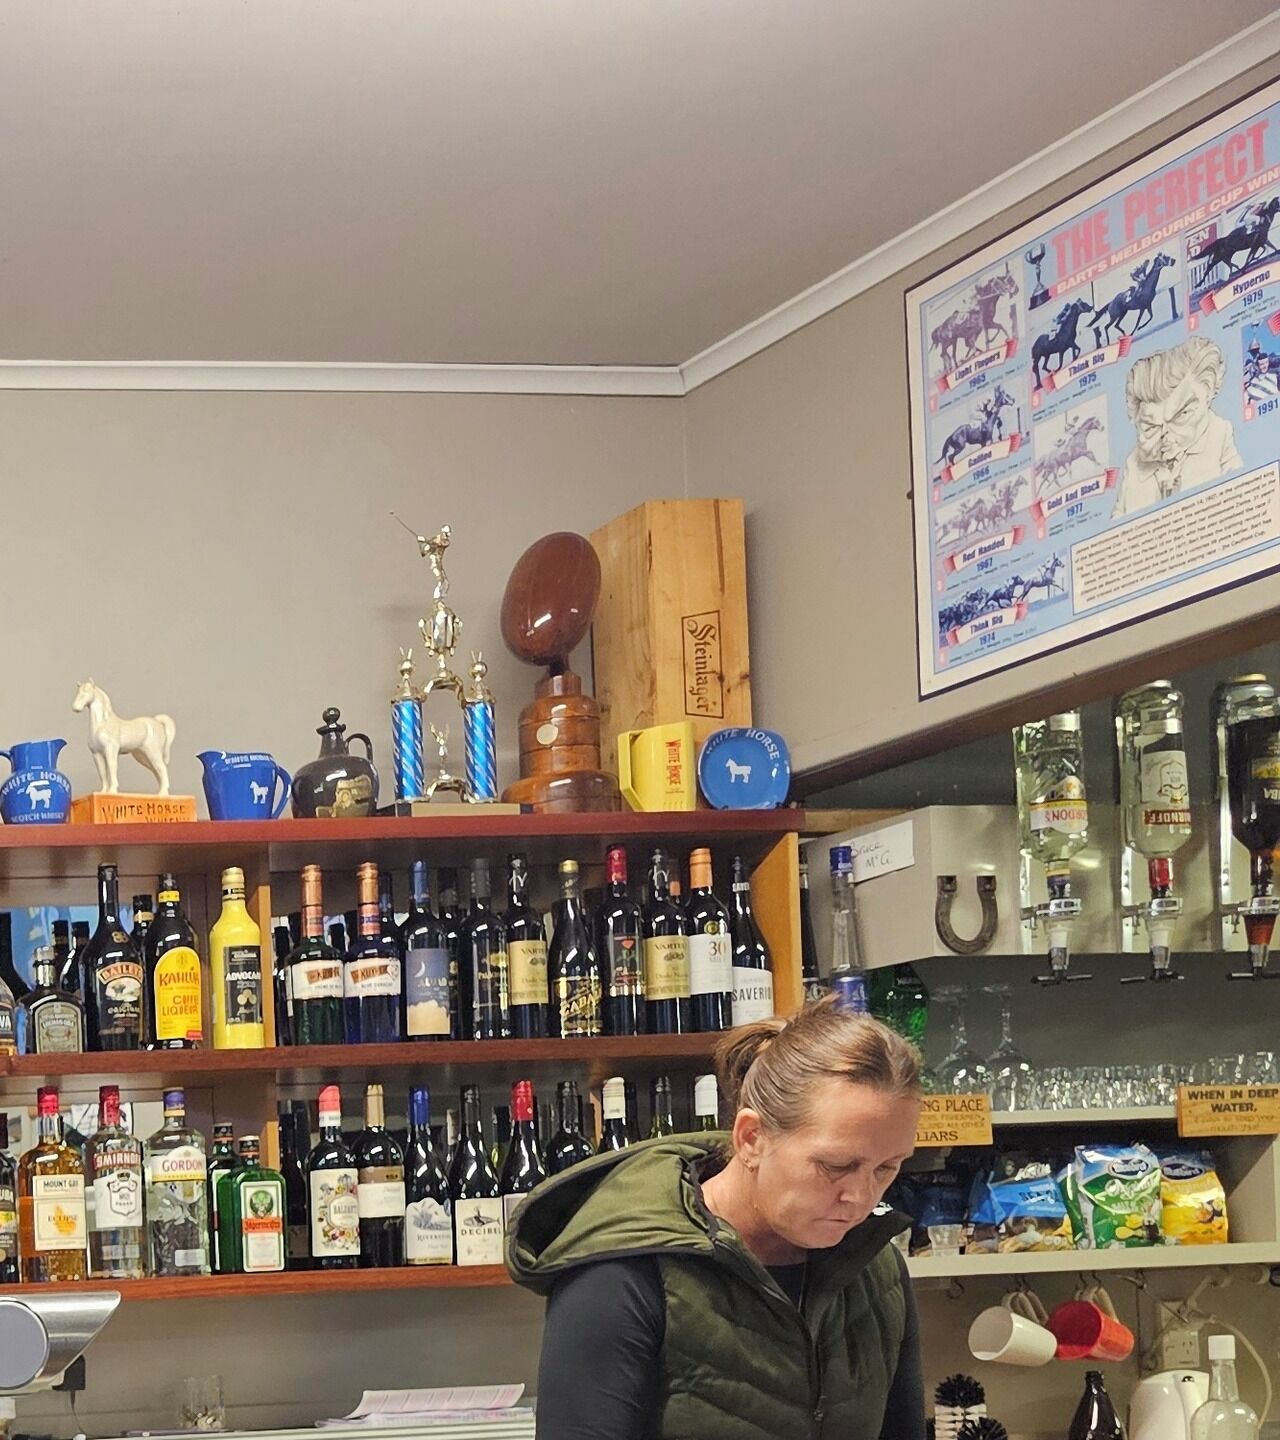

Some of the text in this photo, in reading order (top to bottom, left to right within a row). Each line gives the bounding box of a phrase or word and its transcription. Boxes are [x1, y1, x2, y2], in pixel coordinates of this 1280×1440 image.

[1049, 119, 1269, 279] THE PERFECT
[1057, 258, 1108, 294] BART'S
[1111, 205, 1207, 267] MELBOURNE
[1209, 186, 1244, 212] CUP
[1233, 270, 1270, 295] Hyperno
[1243, 289, 1263, 306] 1979
[1258, 398, 1279, 416] 1991
[687, 620, 720, 714] Steinlager
[745, 729, 780, 760] HORSE
[2, 771, 70, 795] WHITE HORSE
[102, 803, 186, 824] WHITE HORSE
[709, 940, 727, 956] 30
[732, 986, 772, 1002] SAVERIO
[1187, 1087, 1279, 1101] WHEN IN DEEP
[944, 1098, 983, 1112] PLACE
[43, 1180, 64, 1188] MOUNT
